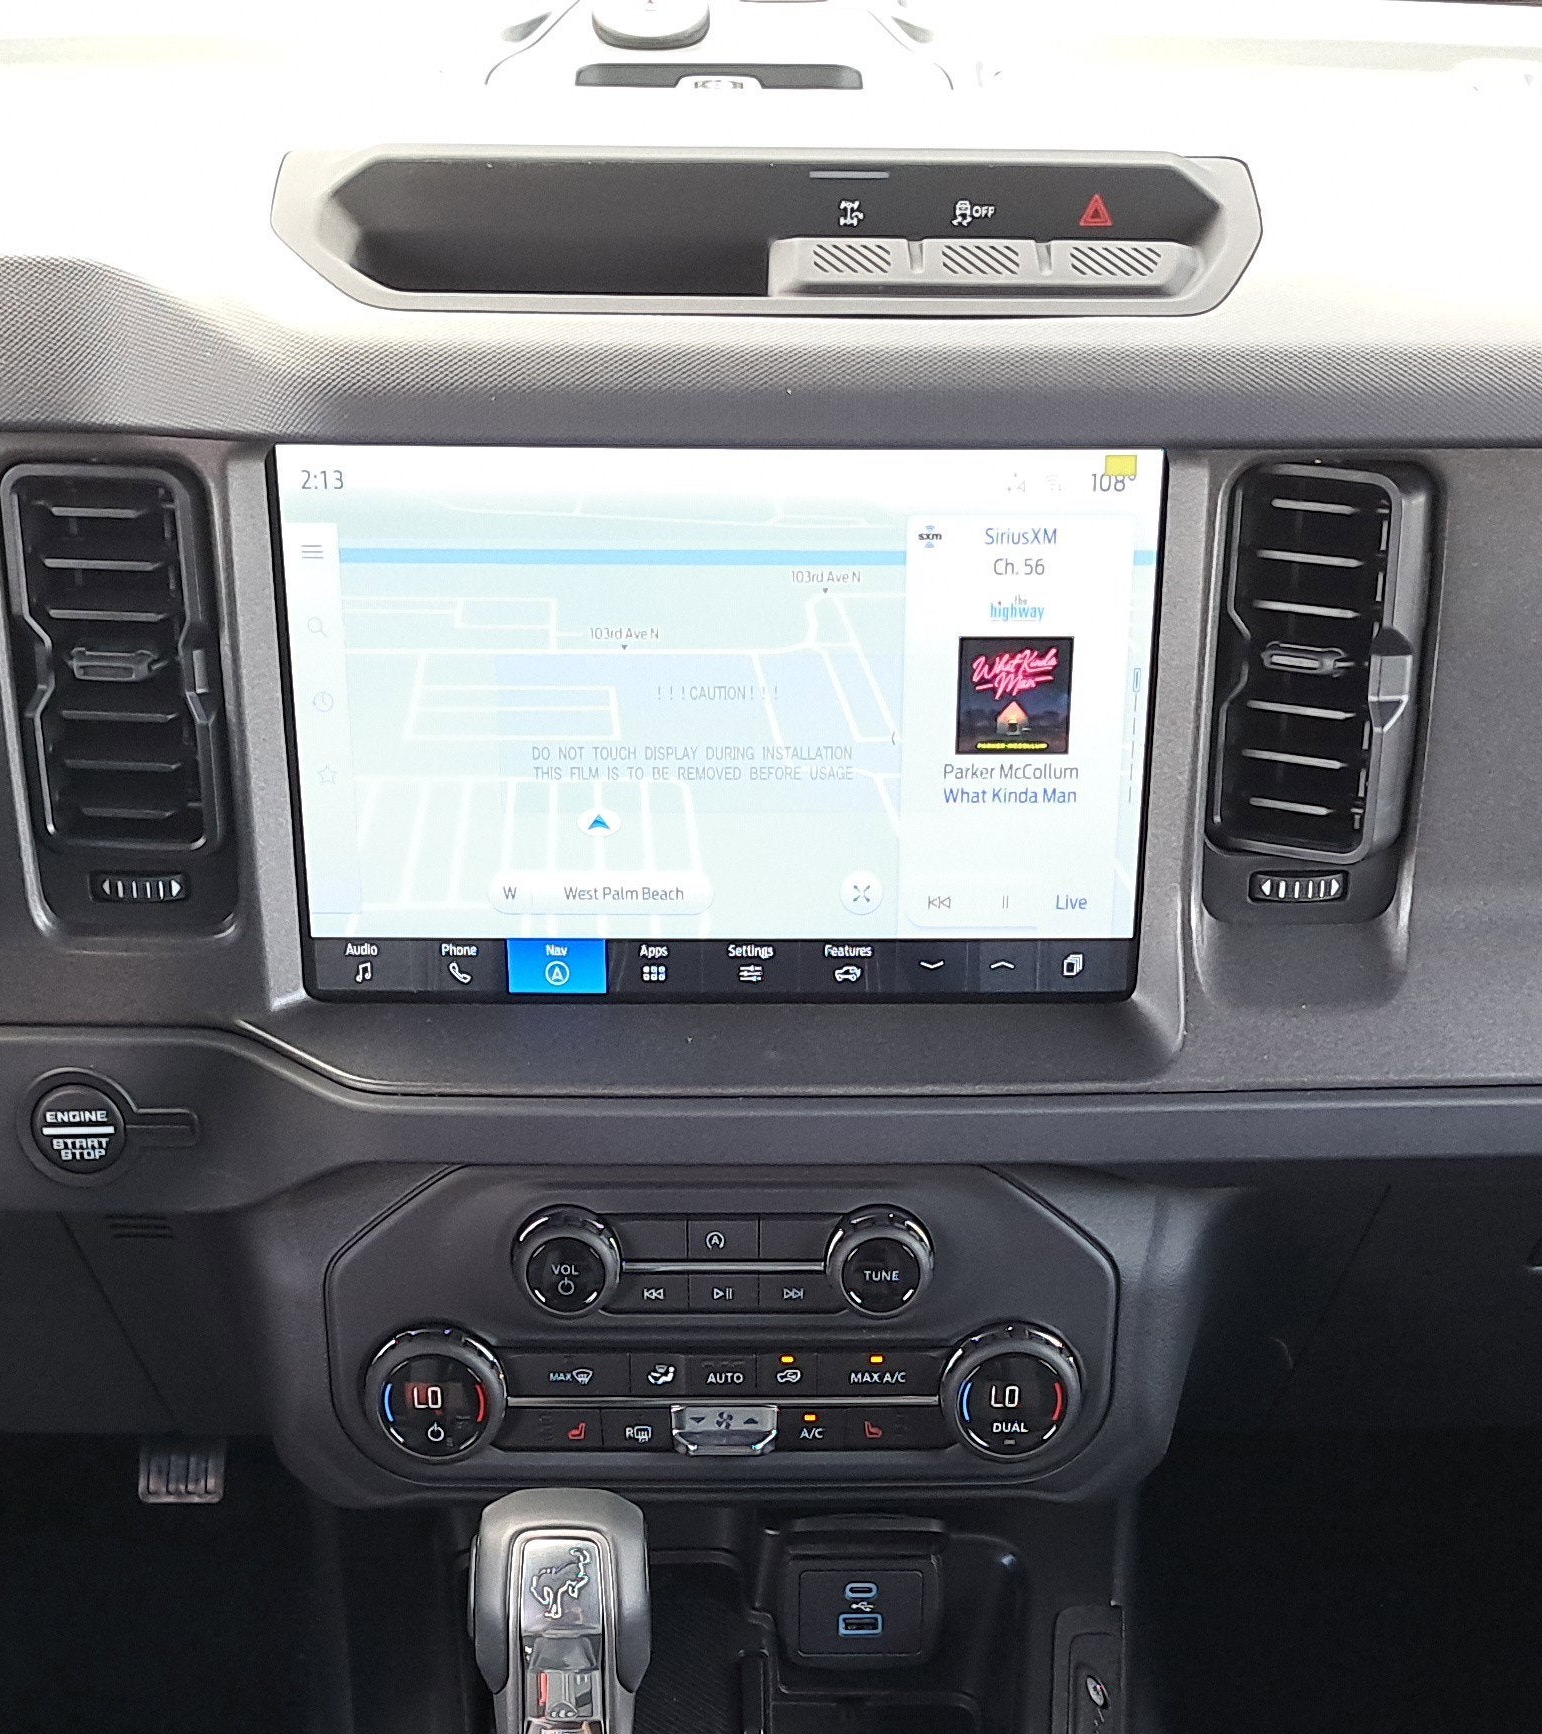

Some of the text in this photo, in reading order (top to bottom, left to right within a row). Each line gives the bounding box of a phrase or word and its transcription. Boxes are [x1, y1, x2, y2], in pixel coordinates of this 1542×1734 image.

[972, 205, 996, 219] OFF
[300, 469, 345, 491] 2:13
[917, 530, 943, 542] sxm
[984, 527, 1059, 546] SiriusXM
[993, 558, 1046, 577] Ch. 56
[791, 570, 862, 584] 103rd Ave N
[990, 600, 1046, 622] highway
[589, 627, 660, 640] 103rd Ave N
[971, 652, 1015, 683] What
[531, 745, 853, 762] DO NOT TOUCH DISPLAY DURING INSTALLATION
[533, 766, 854, 781] THIS FILM IS TO BE REMOVED BEFORE USAGE
[943, 763, 1080, 780] Parker McCollum
[943, 787, 1078, 804] What Kinda Man
[502, 886, 517, 900] W
[563, 886, 684, 901] West Palm Beach
[1055, 894, 1089, 911] Live
[345, 942, 378, 957] Audio
[441, 943, 478, 957] Phone
[545, 944, 568, 957] Nav
[639, 944, 669, 958] Apps
[727, 944, 775, 959] Settings
[824, 944, 873, 957] Features
[45, 1110, 108, 1123] ENGINE
[52, 1137, 110, 1150] START
[60, 1148, 106, 1160] STOP
[551, 1264, 581, 1276] VOL
[863, 1269, 900, 1282] TUNE
[549, 1371, 573, 1383] MAX
[706, 1371, 745, 1385] AUTO
[850, 1371, 907, 1385] MAX A/C
[412, 1385, 443, 1409] LO
[989, 1384, 1020, 1409] LO
[799, 1426, 824, 1440] A/C
[992, 1421, 1030, 1434] DUAL
